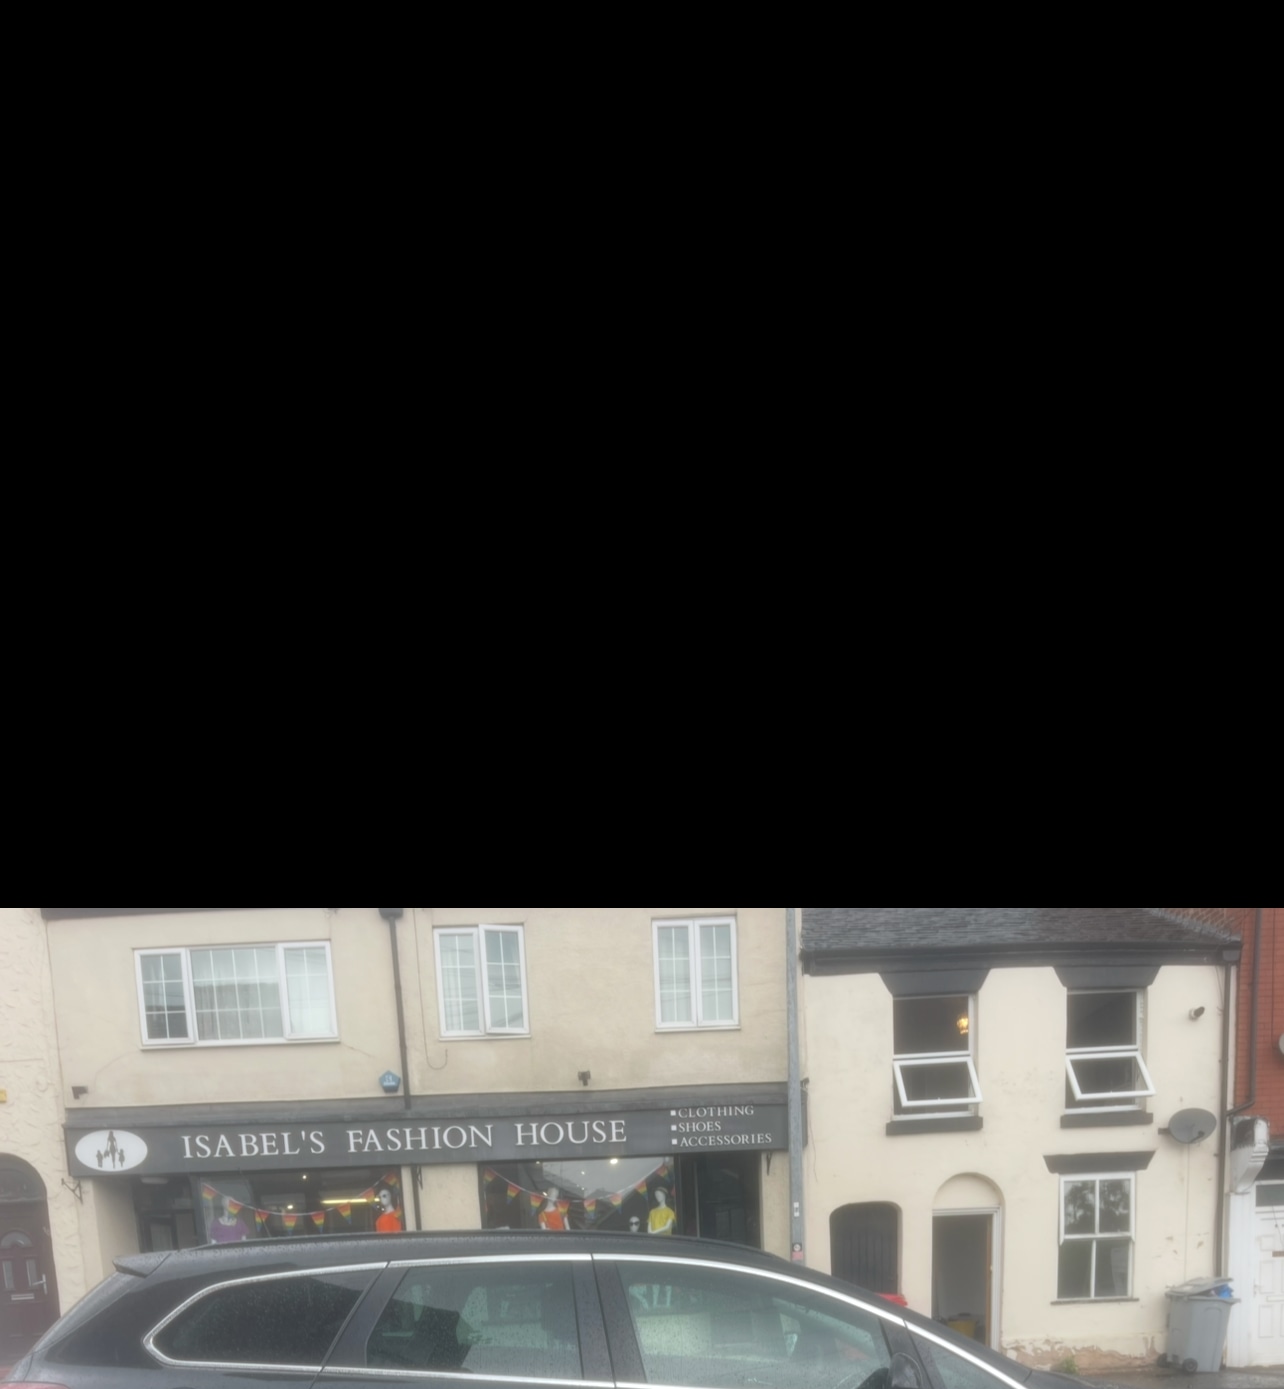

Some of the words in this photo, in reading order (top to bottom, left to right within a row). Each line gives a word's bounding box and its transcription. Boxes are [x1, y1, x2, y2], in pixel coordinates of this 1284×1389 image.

[678, 1105, 754, 1118] CLOTHING
[678, 1121, 722, 1133] SHOES
[181, 1130, 326, 1159] ISABEL'S
[346, 1124, 494, 1153] FASHION
[514, 1119, 627, 1146] HOUSE
[679, 1133, 772, 1147] ACCESSORIES
